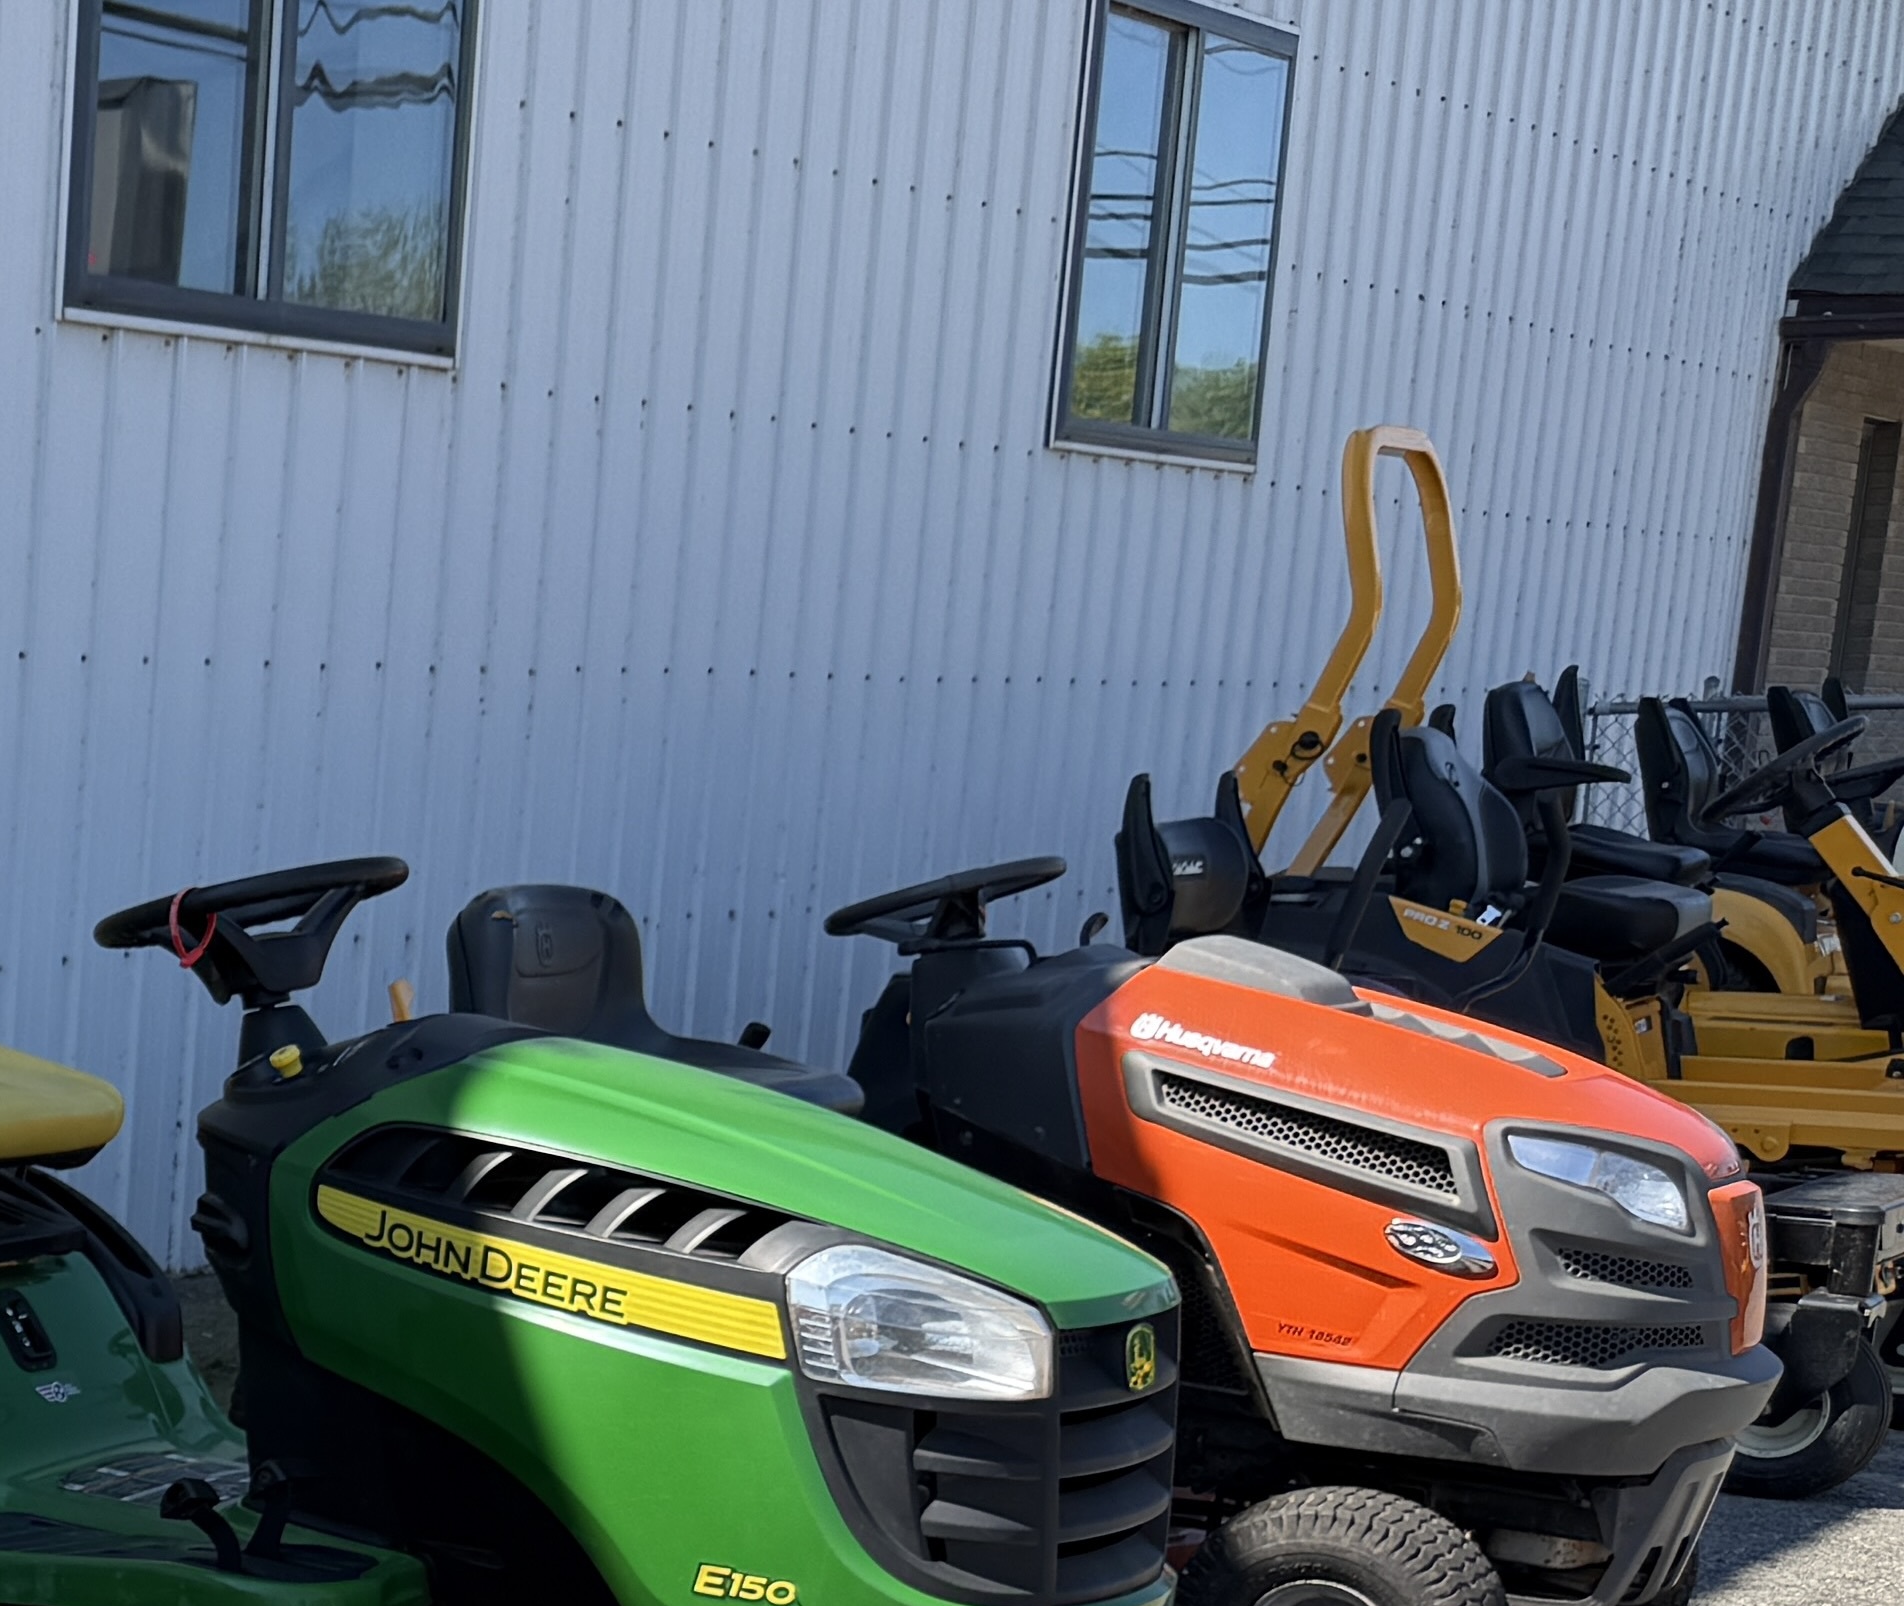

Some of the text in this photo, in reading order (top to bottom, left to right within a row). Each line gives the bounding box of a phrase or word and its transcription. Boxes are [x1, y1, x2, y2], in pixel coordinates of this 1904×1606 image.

[1456, 924, 1483, 940] 100
[1154, 1020, 1276, 1069] Husqvarna
[365, 1210, 628, 1318] JOHN DEERE
[693, 1563, 797, 1606] E150
